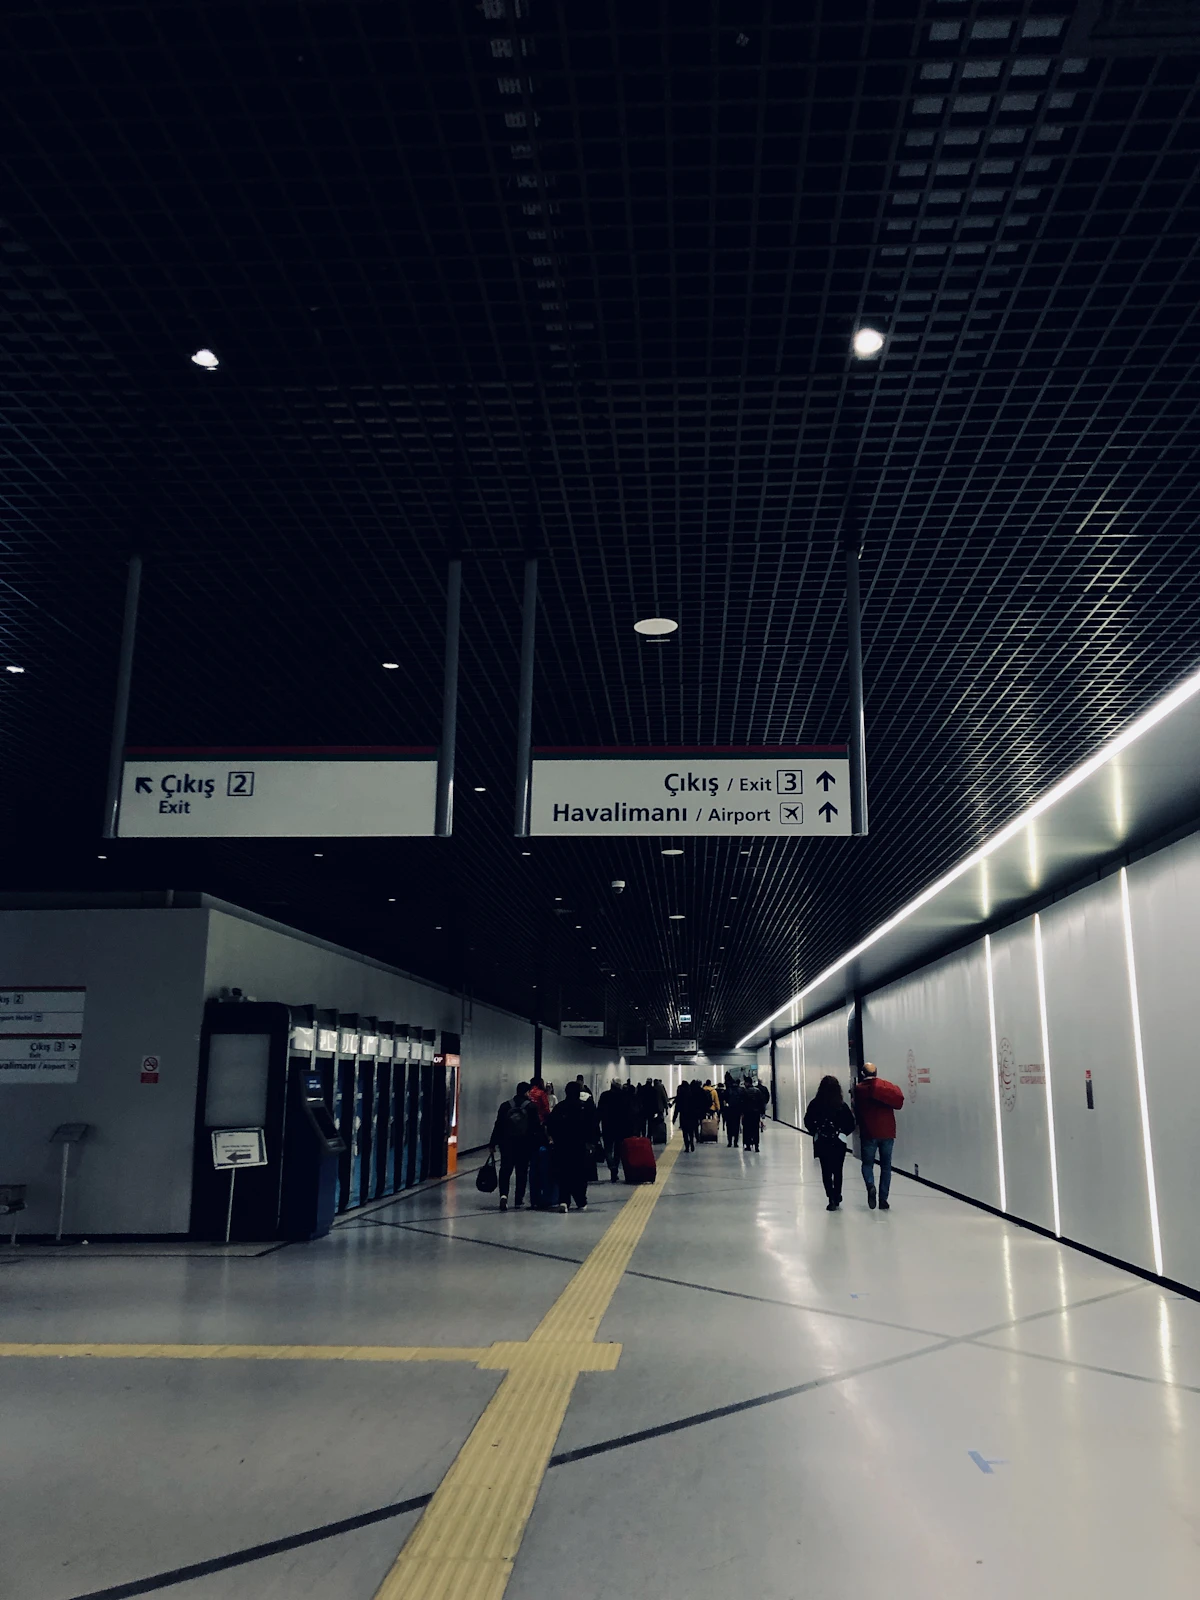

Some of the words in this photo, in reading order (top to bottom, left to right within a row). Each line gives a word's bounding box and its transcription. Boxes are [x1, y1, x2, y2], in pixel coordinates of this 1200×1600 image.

[160, 773, 215, 798] Çıkış
[232, 775, 247, 793] 2
[664, 772, 719, 797] Çıkış
[739, 777, 772, 792] Exit
[784, 773, 797, 791] 3
[158, 800, 191, 814] Exit
[553, 801, 687, 822] Havalimanı
[707, 808, 771, 825] Airport
[29, 1042, 51, 1053] Çıkış
